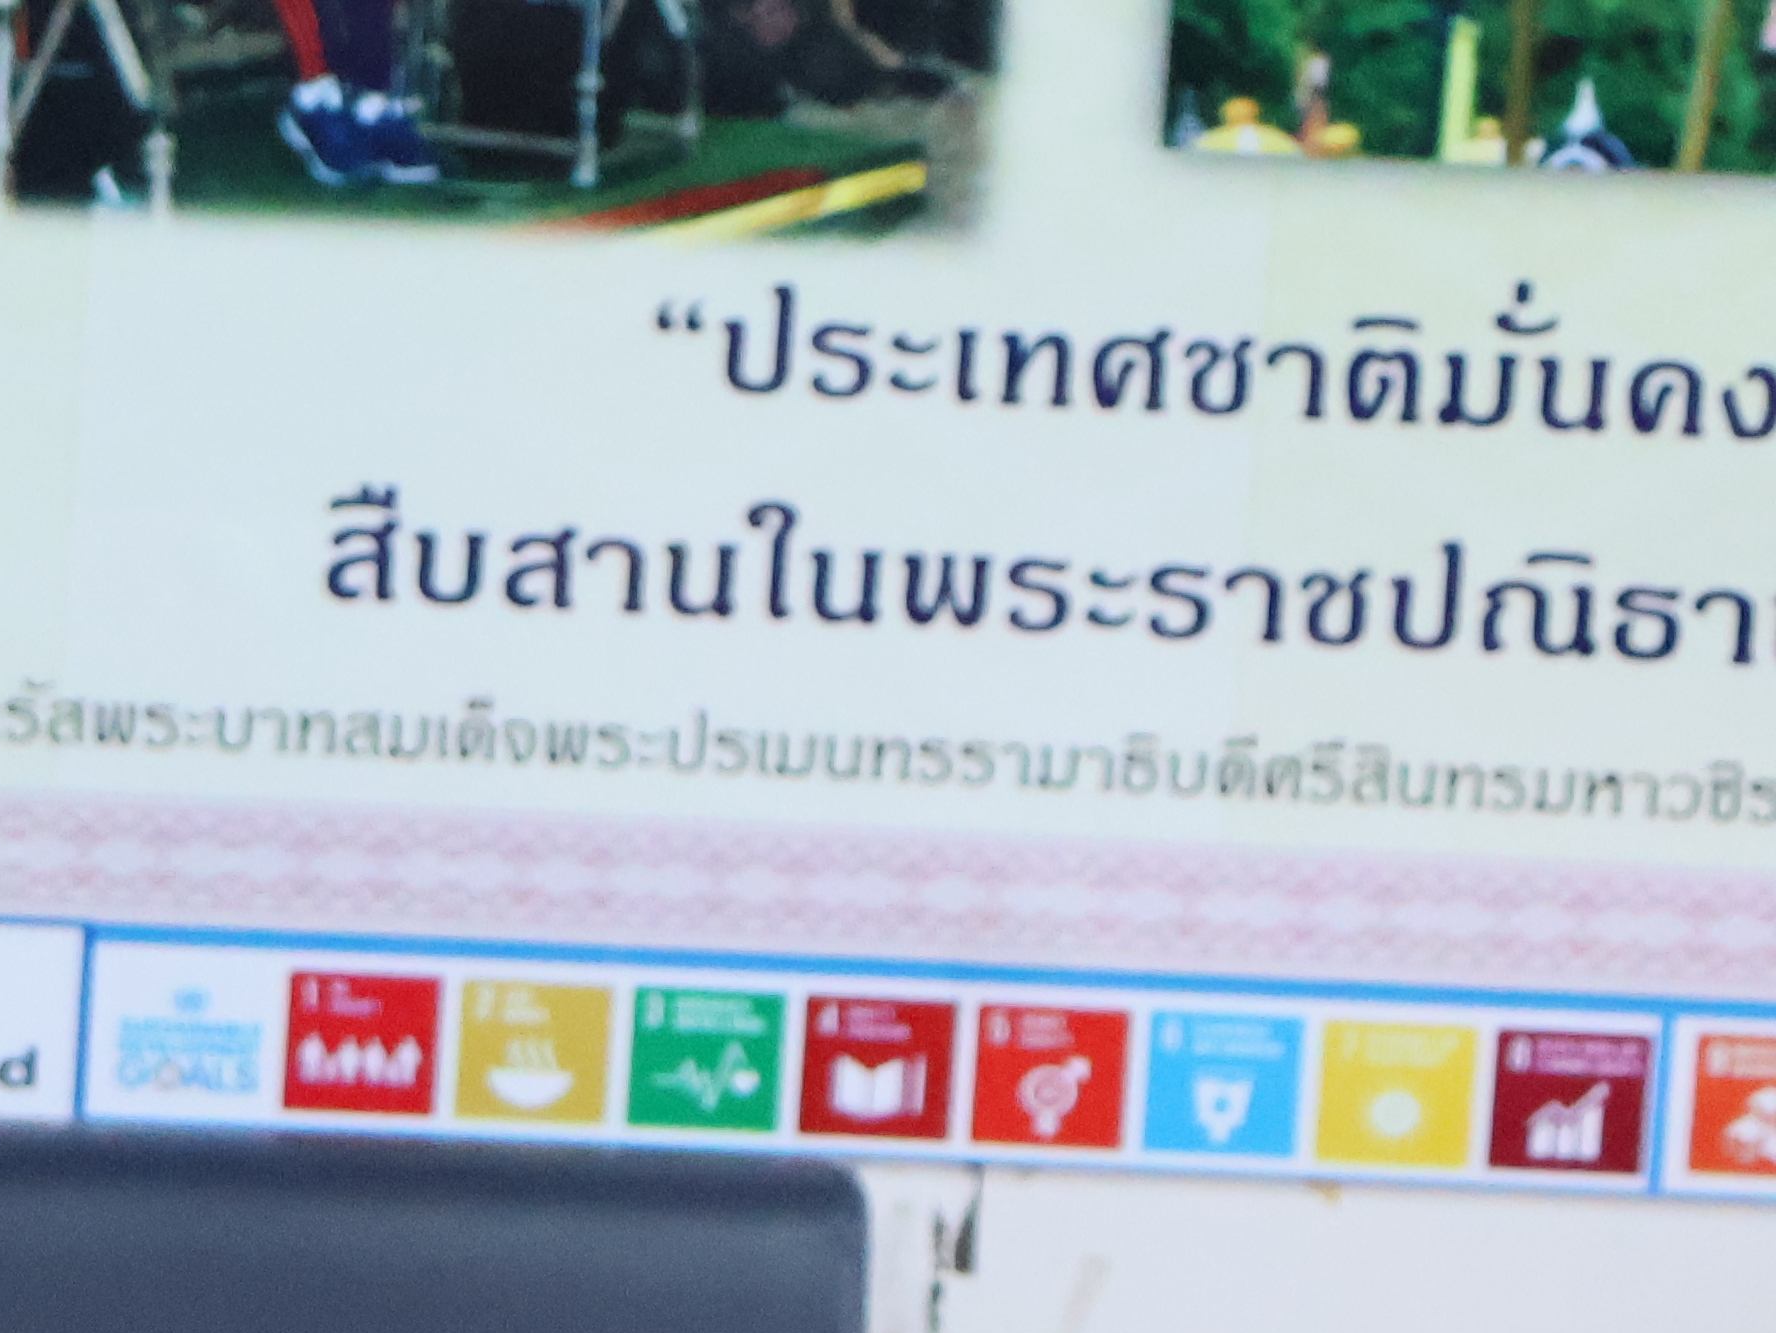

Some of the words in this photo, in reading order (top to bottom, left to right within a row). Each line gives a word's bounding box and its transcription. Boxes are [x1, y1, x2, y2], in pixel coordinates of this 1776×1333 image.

[325, 483, 1776, 666] สืบสานในพระราชปณิธา
